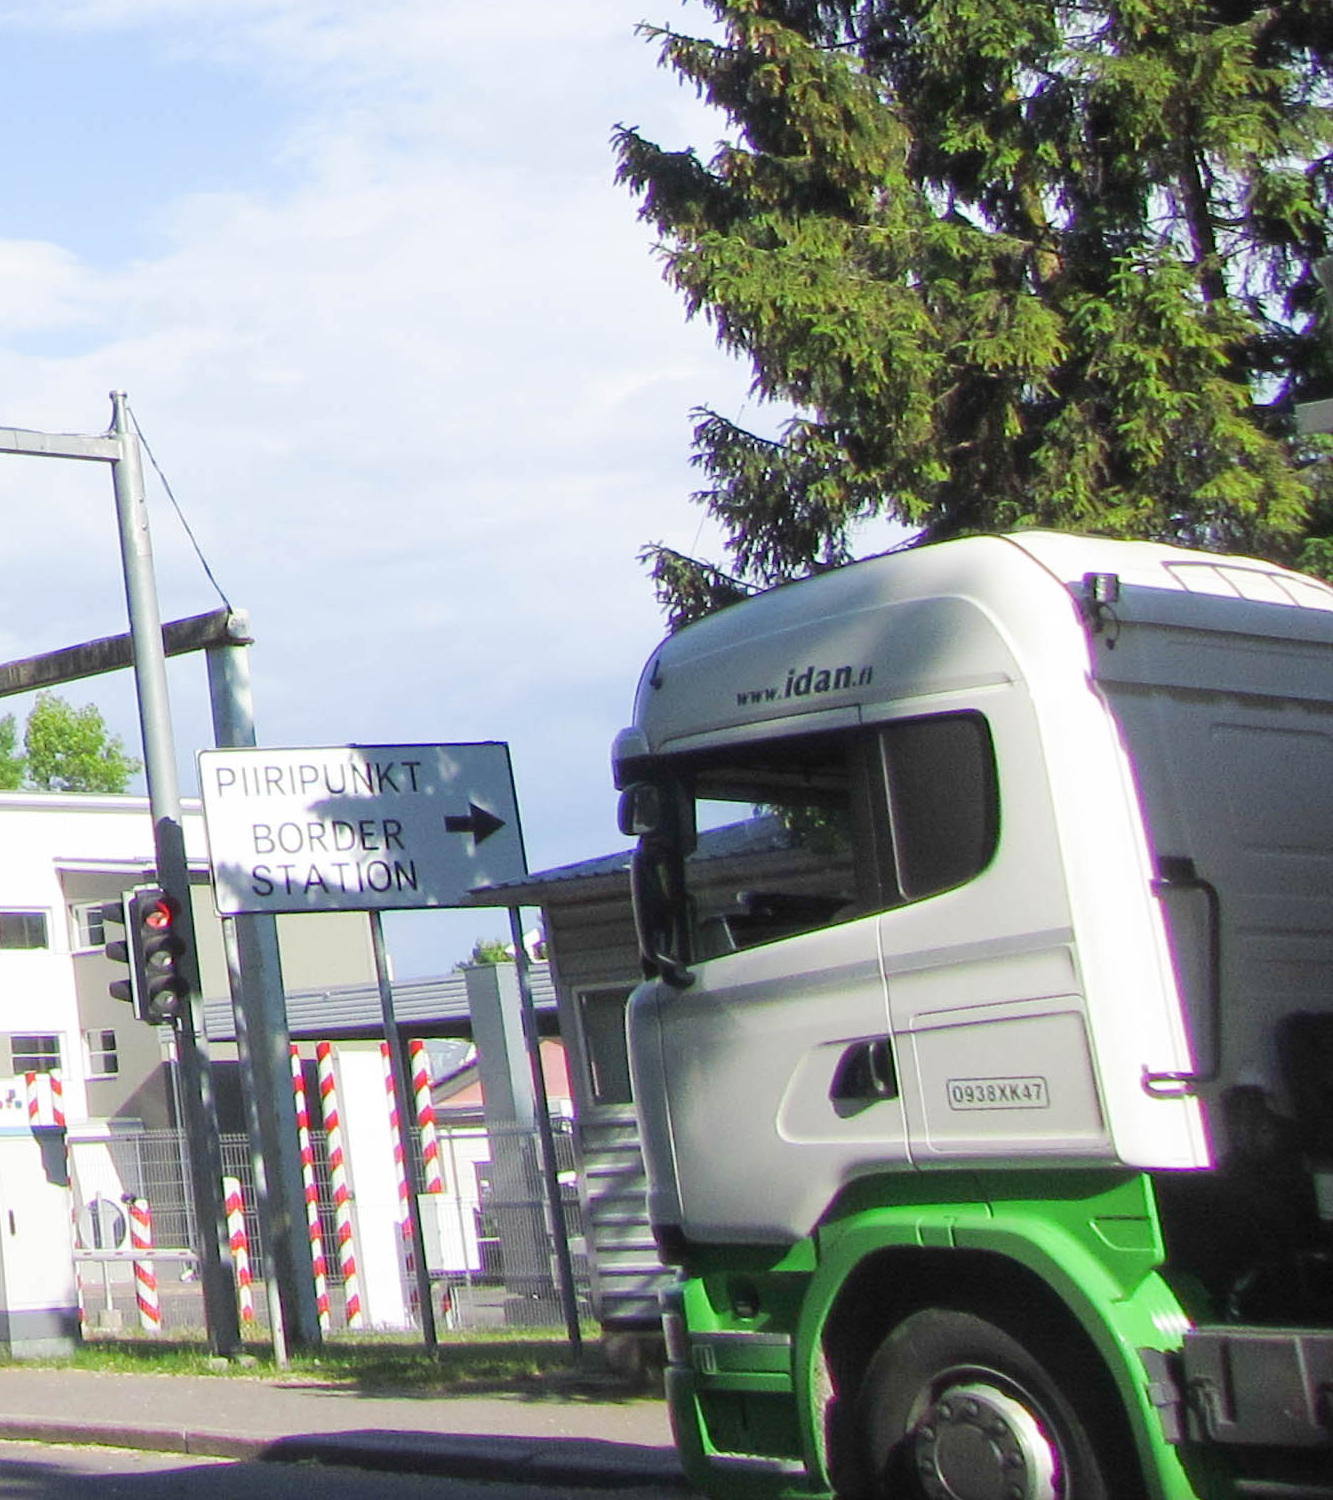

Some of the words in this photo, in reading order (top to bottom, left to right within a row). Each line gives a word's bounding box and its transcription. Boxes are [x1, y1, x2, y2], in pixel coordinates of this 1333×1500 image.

[736, 665, 874, 706] www.idan.fi
[215, 760, 422, 797] PIIRIPUNKT
[251, 818, 406, 855] BORDER
[251, 860, 419, 897] STATION
[953, 1083, 1042, 1103] 0938XK47
